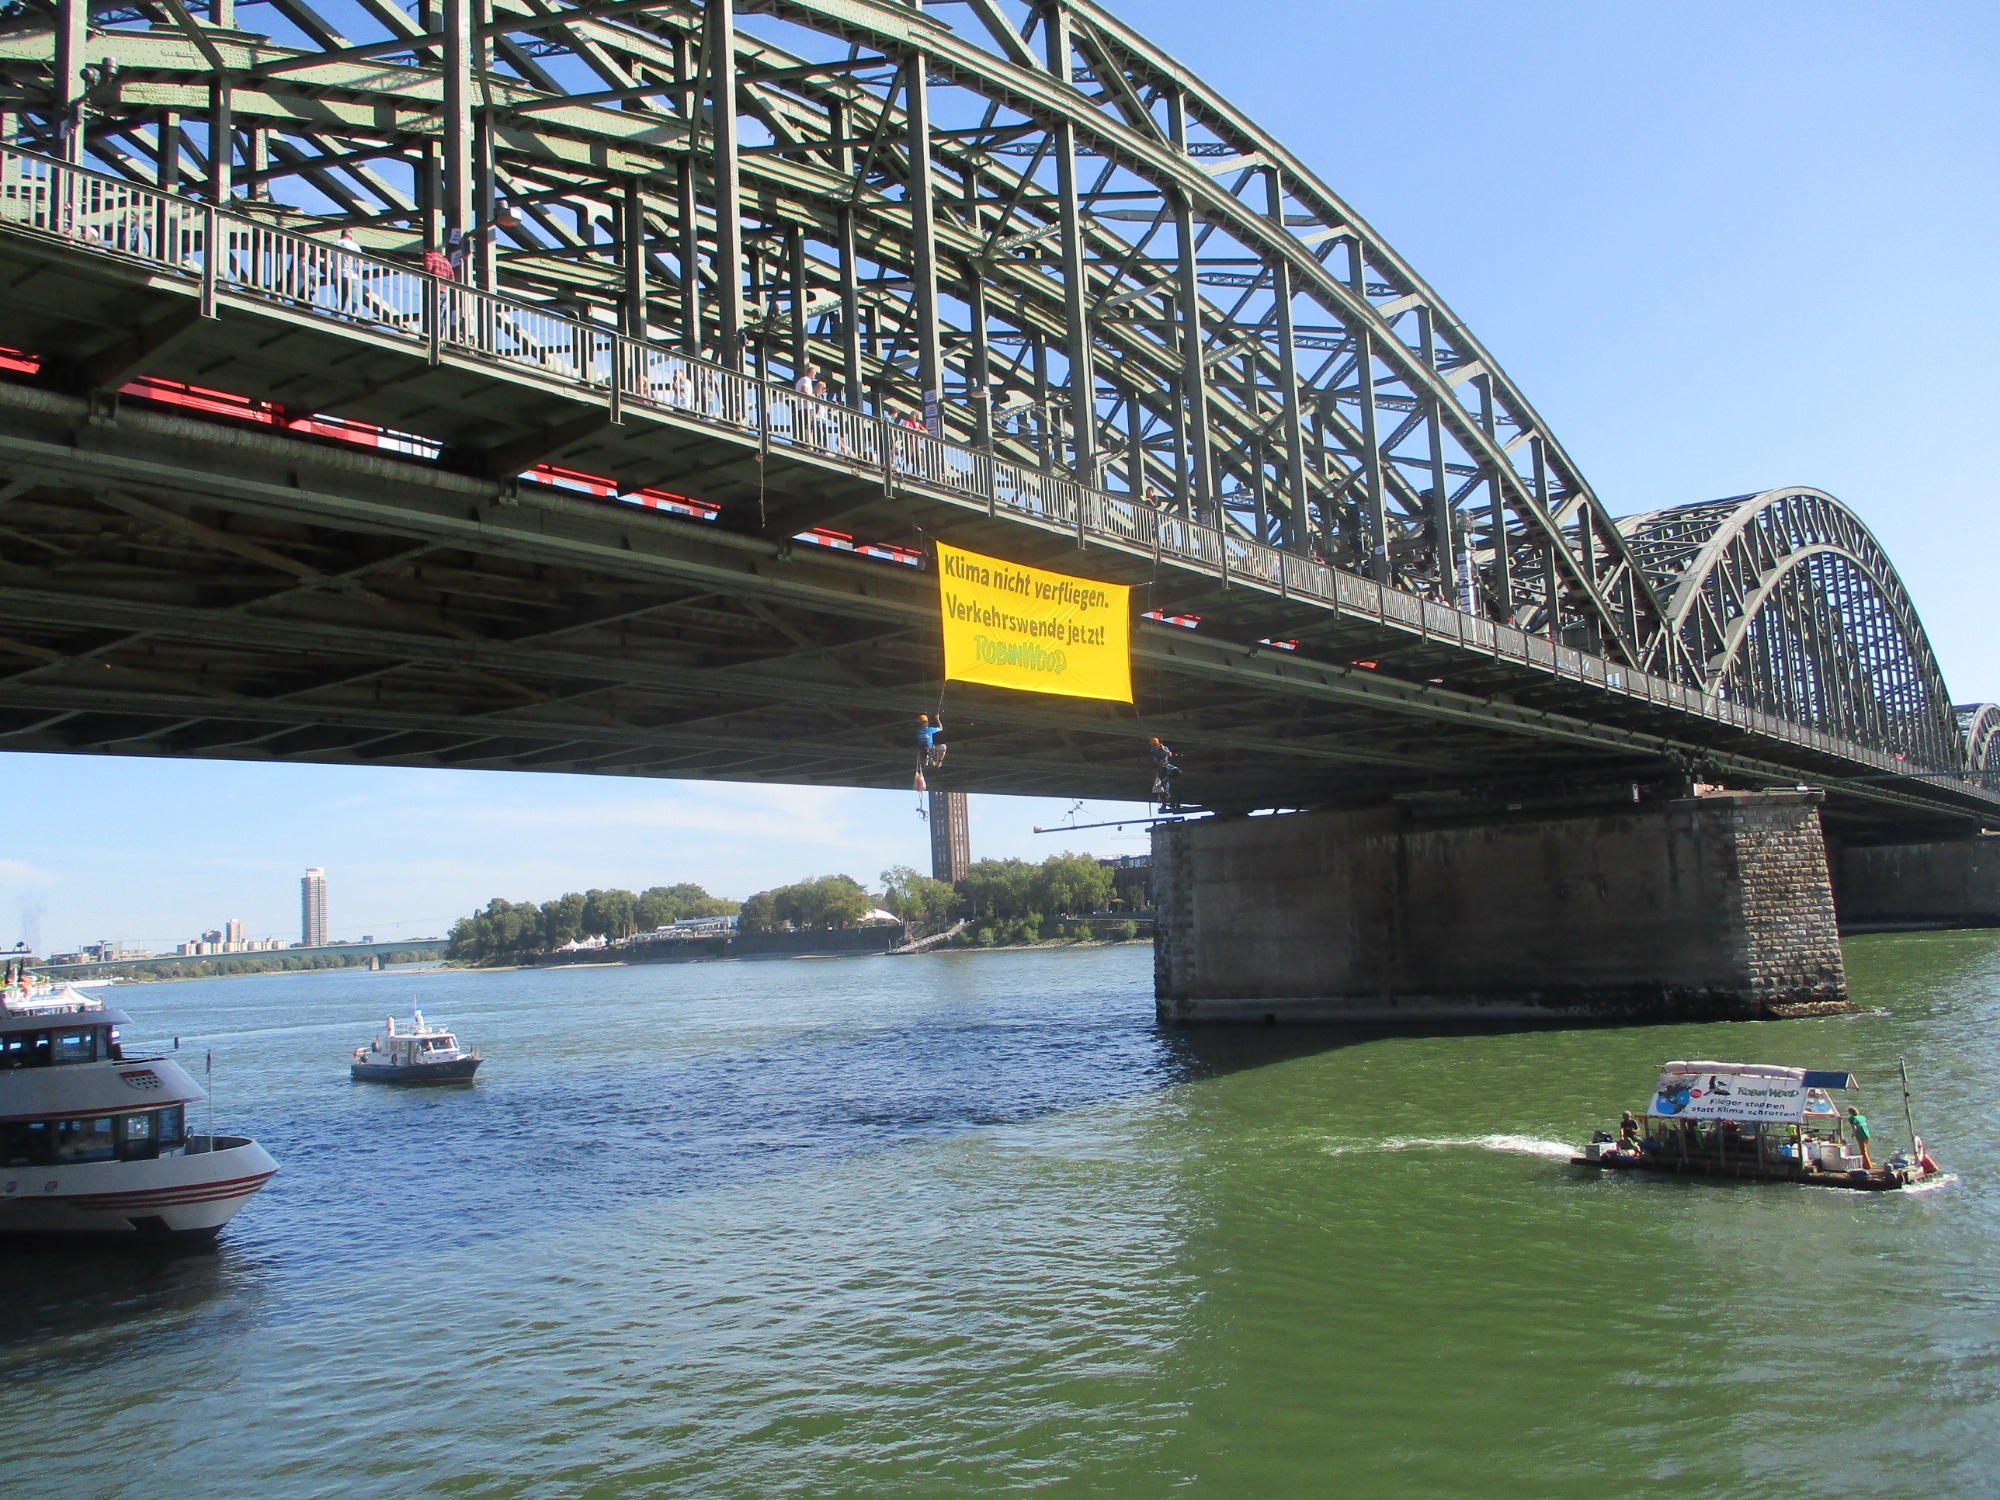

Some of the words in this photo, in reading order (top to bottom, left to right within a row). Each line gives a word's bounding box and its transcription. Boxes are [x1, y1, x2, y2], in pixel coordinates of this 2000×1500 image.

[945, 554, 989, 586] Klima
[994, 568, 1030, 596] nicht
[1035, 581, 1109, 611] verfliegen.
[946, 592, 1065, 641] Verkehrswende
[1066, 620, 1105, 646] jetzt!
[1709, 1099, 1742, 1107] Flieger
[1745, 1101, 1785, 1110] stoppen
